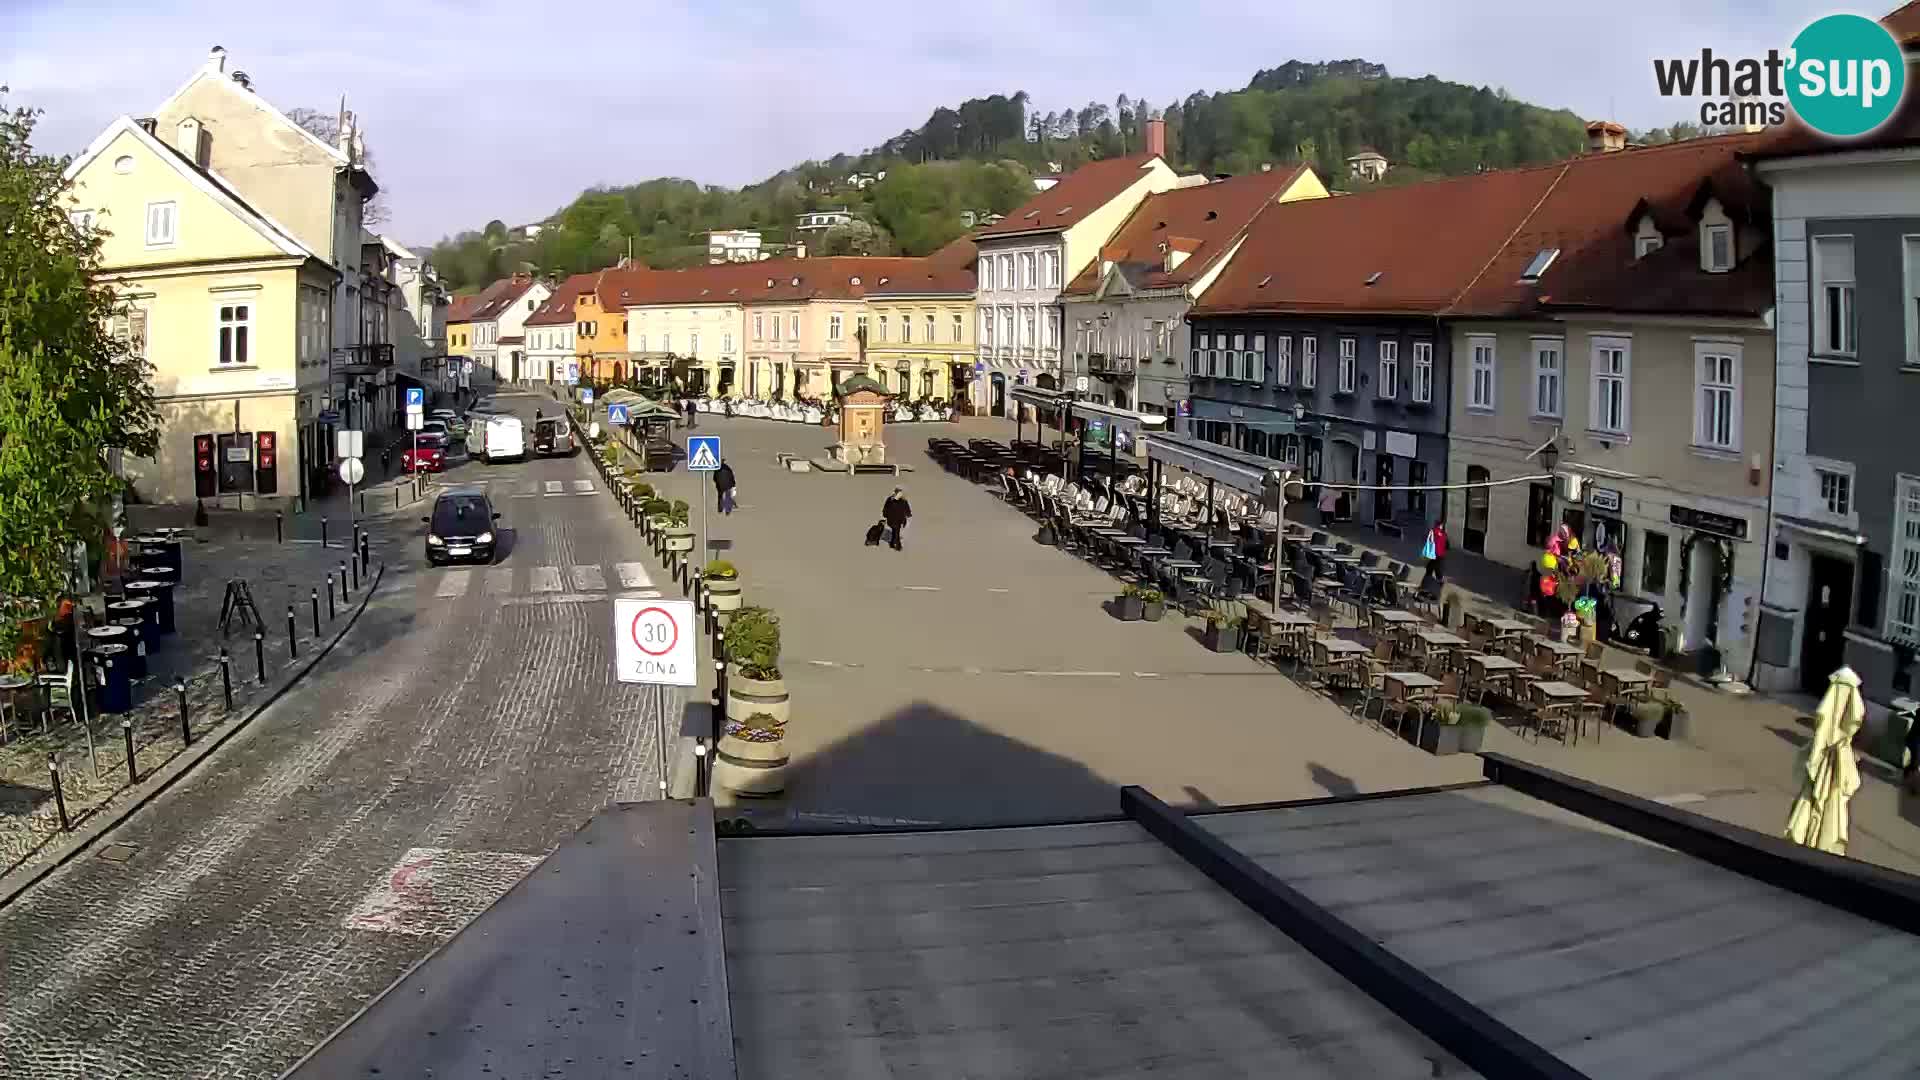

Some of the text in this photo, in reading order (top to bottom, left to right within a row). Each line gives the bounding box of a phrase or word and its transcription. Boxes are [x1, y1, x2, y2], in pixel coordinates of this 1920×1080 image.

[410, 391, 420, 403] P
[644, 623, 667, 642] 30
[635, 660, 677, 674] ZONA
